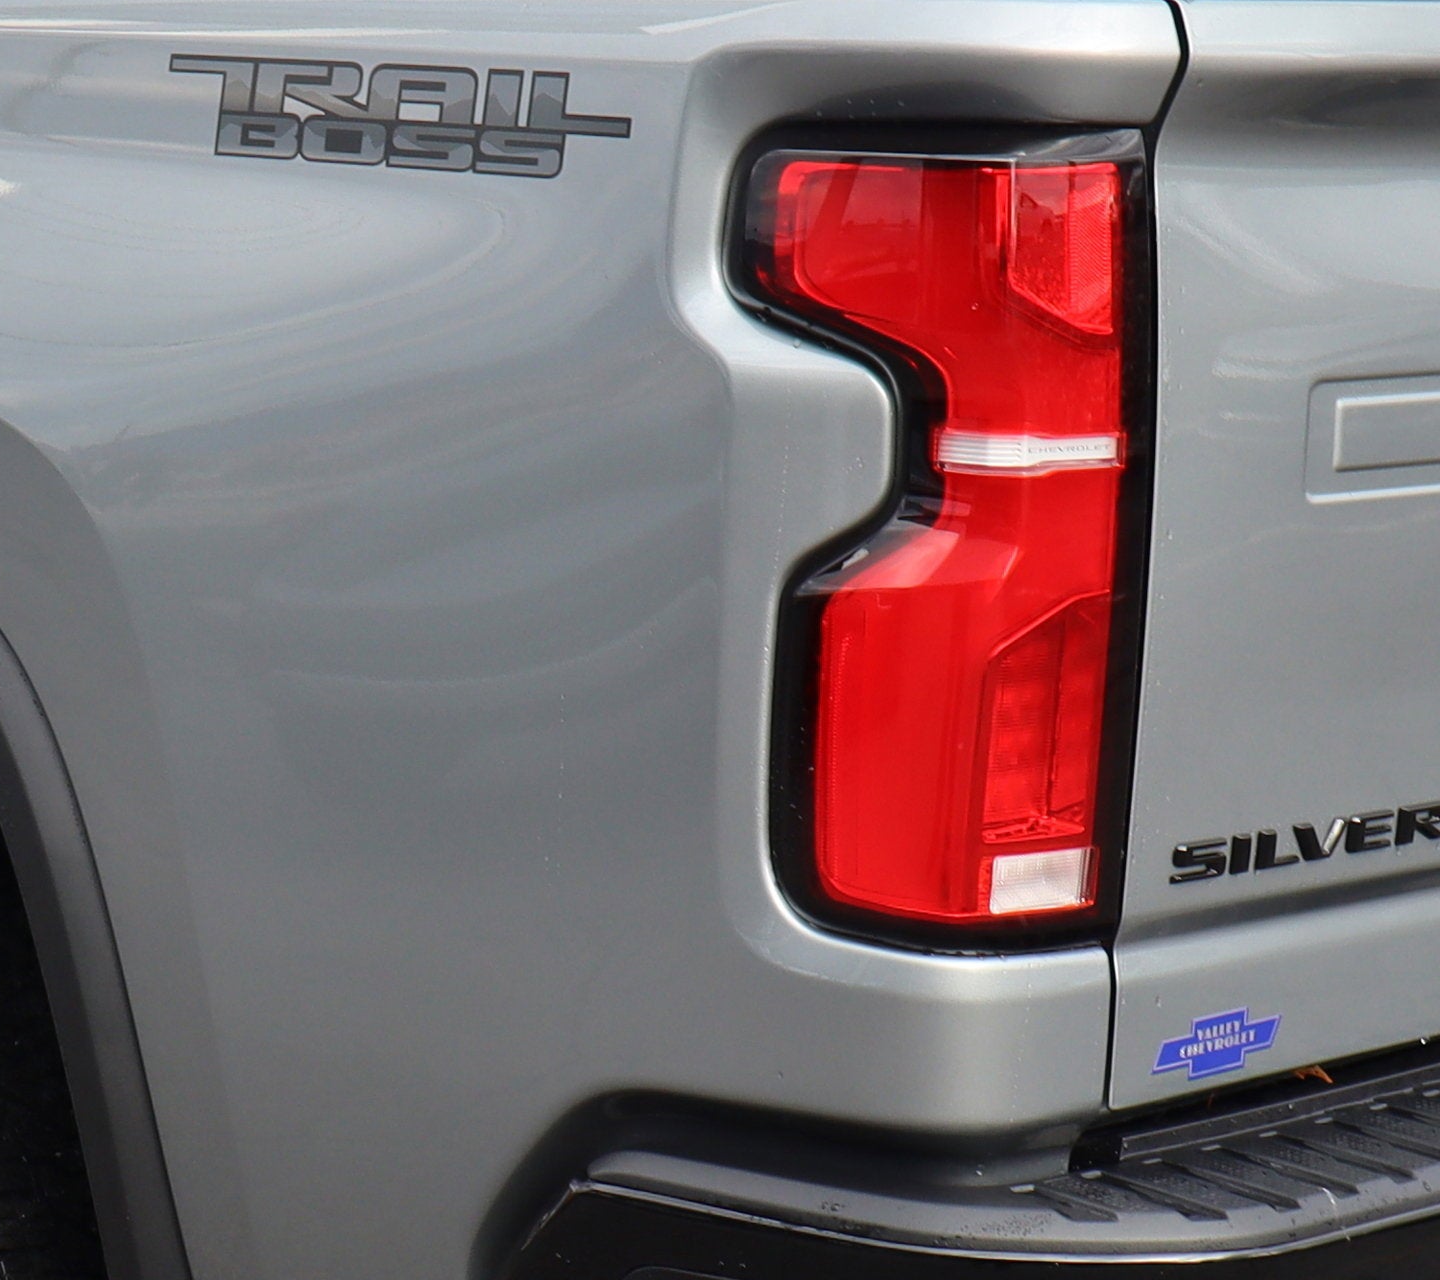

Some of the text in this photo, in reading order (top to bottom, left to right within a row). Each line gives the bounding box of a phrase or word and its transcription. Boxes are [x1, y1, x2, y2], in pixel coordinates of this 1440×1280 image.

[169, 52, 632, 139] TRAIL
[214, 111, 568, 179] BOSS
[1178, 1027, 1257, 1059] CHEVROLET
[1196, 1019, 1243, 1041] VALLEY
